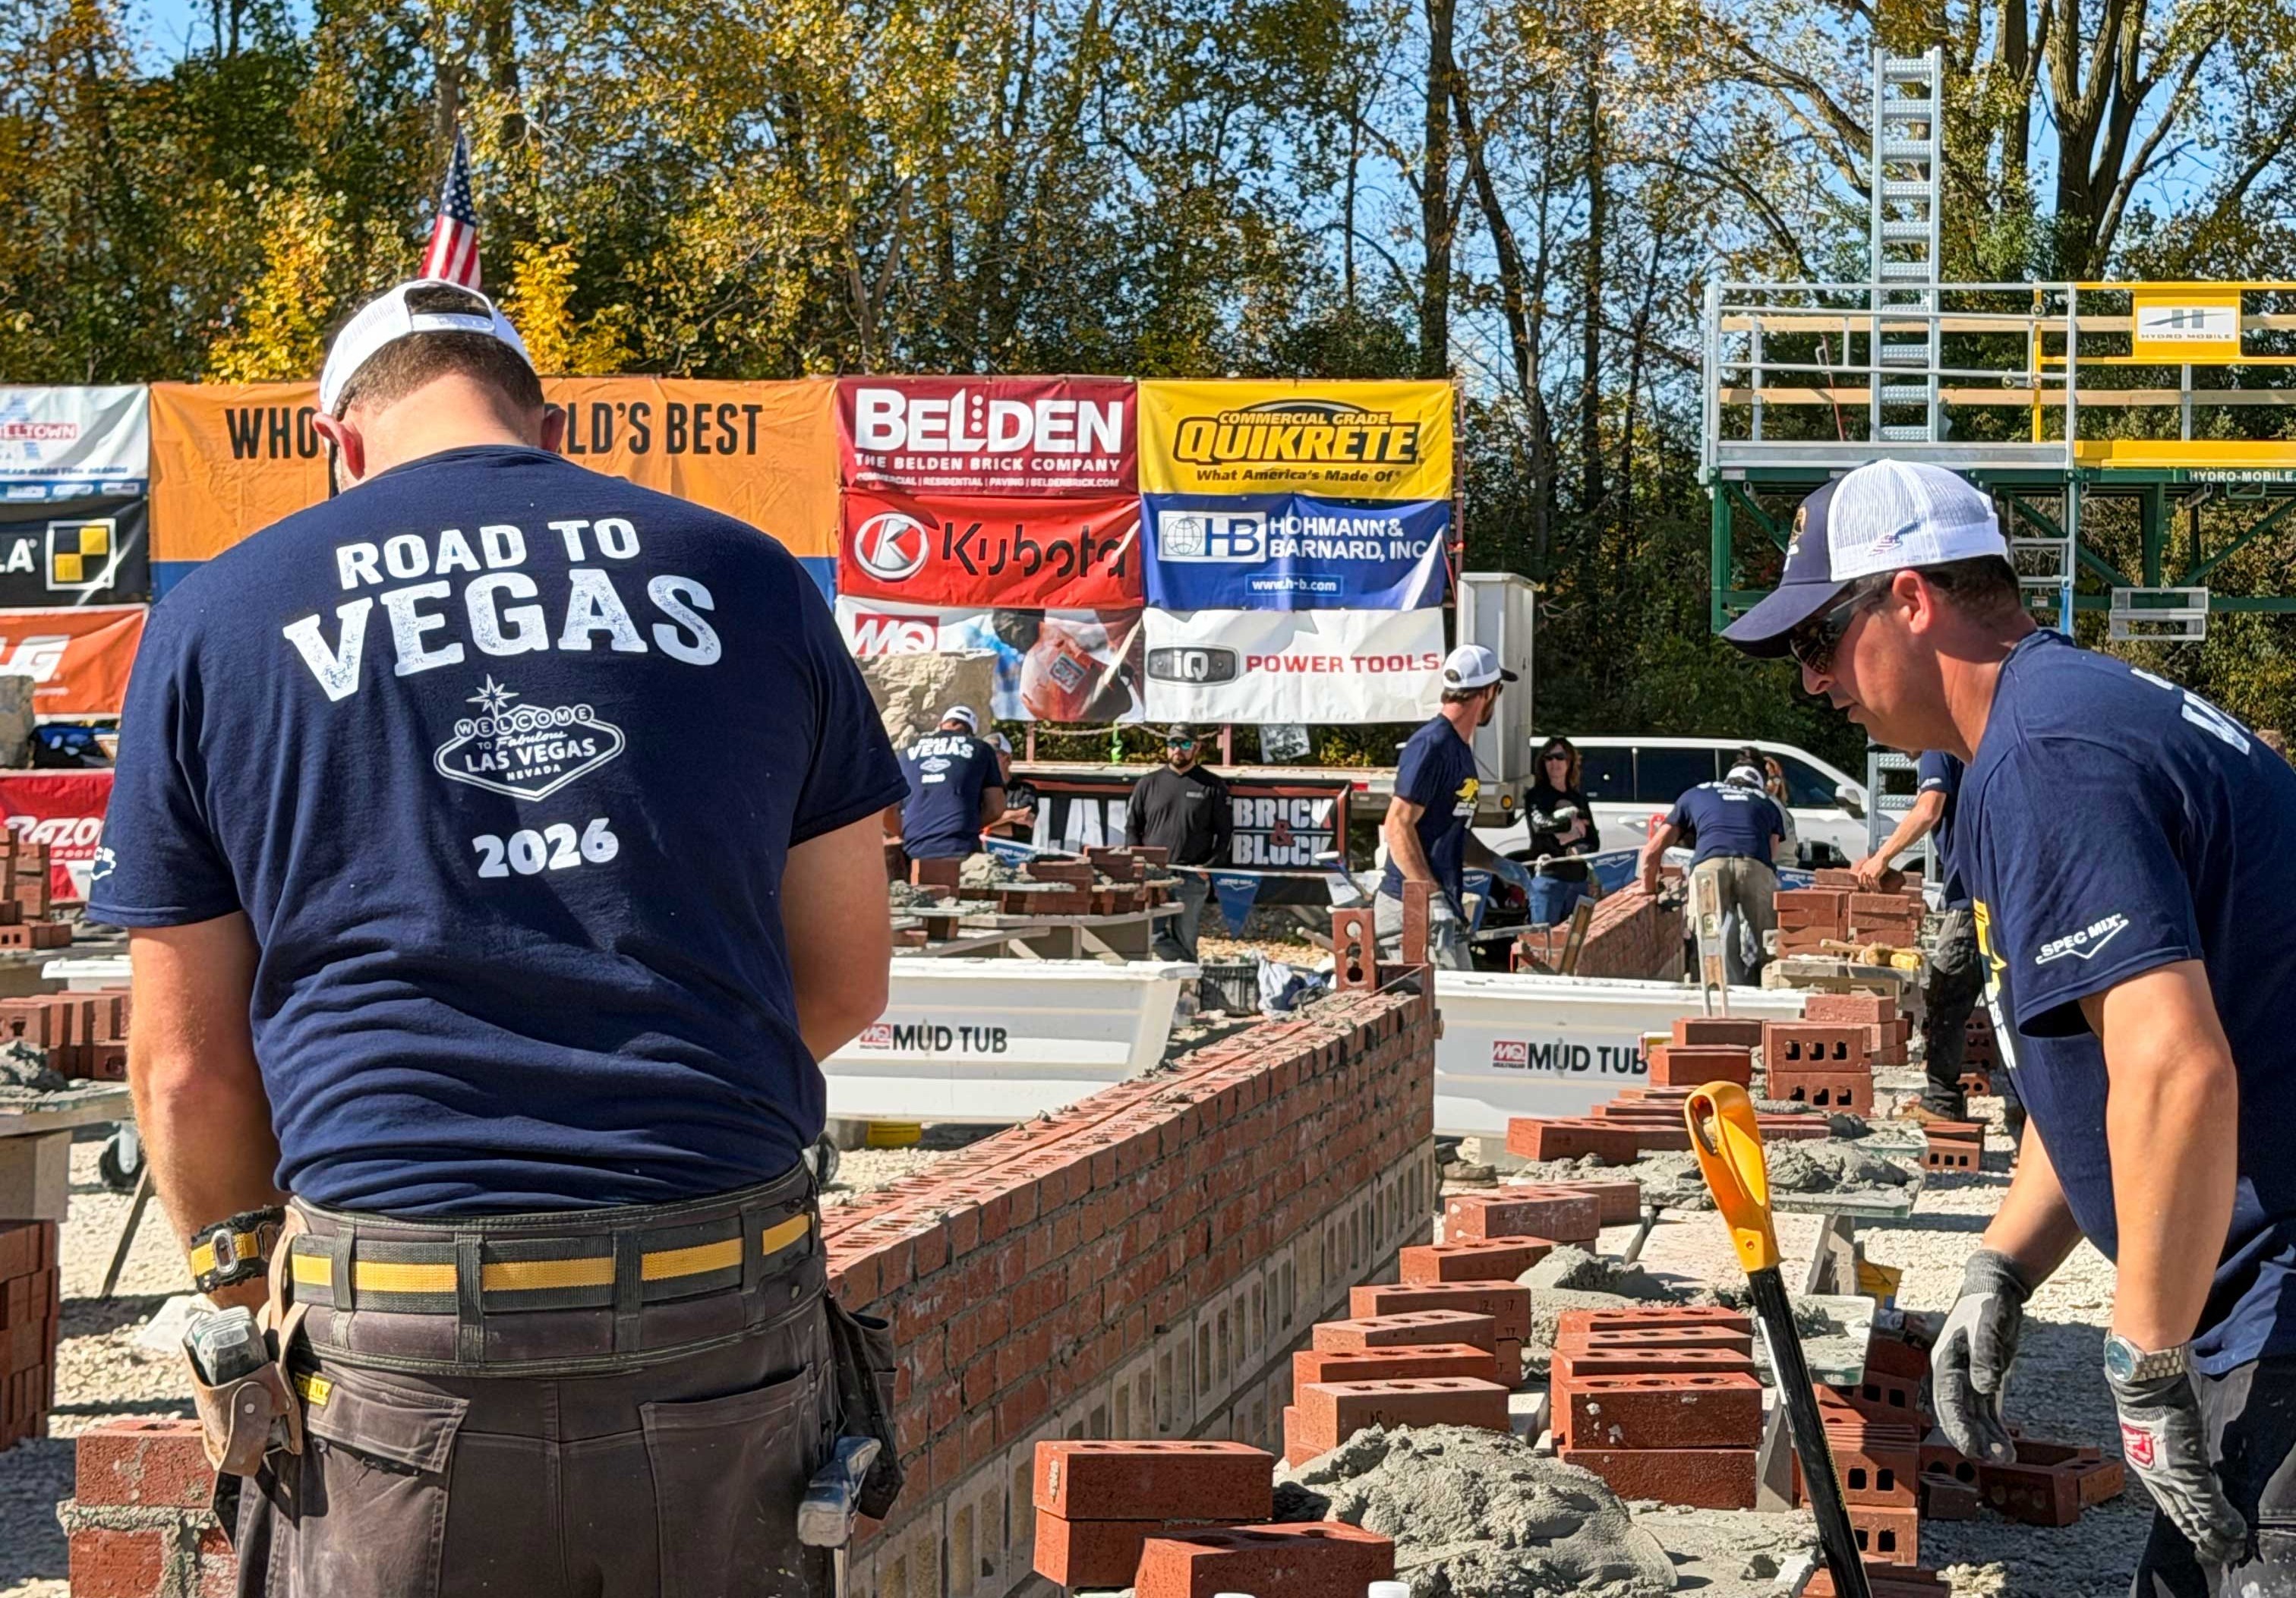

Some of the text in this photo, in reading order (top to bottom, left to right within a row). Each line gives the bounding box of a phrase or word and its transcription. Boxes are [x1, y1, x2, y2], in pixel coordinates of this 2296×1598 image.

[545, 402, 651, 455] LD'S
[666, 402, 763, 455] BEST
[855, 388, 1124, 453] BELDEN
[1219, 412, 1389, 425] COMMERCIAL GRADE
[1176, 420, 1418, 464] QUIKRETE
[854, 453, 1121, 471] THE BELDEN BRICK COMPANY
[1197, 468, 1238, 481] What
[1241, 468, 1321, 481] America's
[1324, 470, 1368, 482] Made
[989, 478, 1024, 487] PAVING
[942, 522, 1127, 579] Kubota
[1204, 516, 1404, 556] HB HOHMANN &
[336, 518, 640, 590] ROAD TO
[1269, 540, 1386, 563] BARNARD,
[1251, 579, 1337, 592] www.h-b.com
[282, 568, 722, 701] VEGAS
[855, 619, 938, 657] MQ
[1246, 655, 1345, 673] POWER
[1351, 653, 1440, 675] TOOLS
[456, 705, 592, 737] WELCOME
[465, 738, 597, 773] LAS VEGAS
[478, 731, 569, 752] TO Fabulous
[506, 764, 562, 781] NEVADA
[1232, 799, 1334, 829] BRICK
[4, 815, 105, 847] RAZO
[1269, 819, 1296, 847] &
[472, 817, 619, 878] 2026
[1232, 834, 1332, 866] BLOCK
[2040, 931, 2088, 957] SPEC
[892, 1025, 953, 1051] MUD
[958, 1026, 1008, 1054] TUB
[1493, 1042, 1526, 1061] MQ
[1527, 1042, 1591, 1072] MUD
